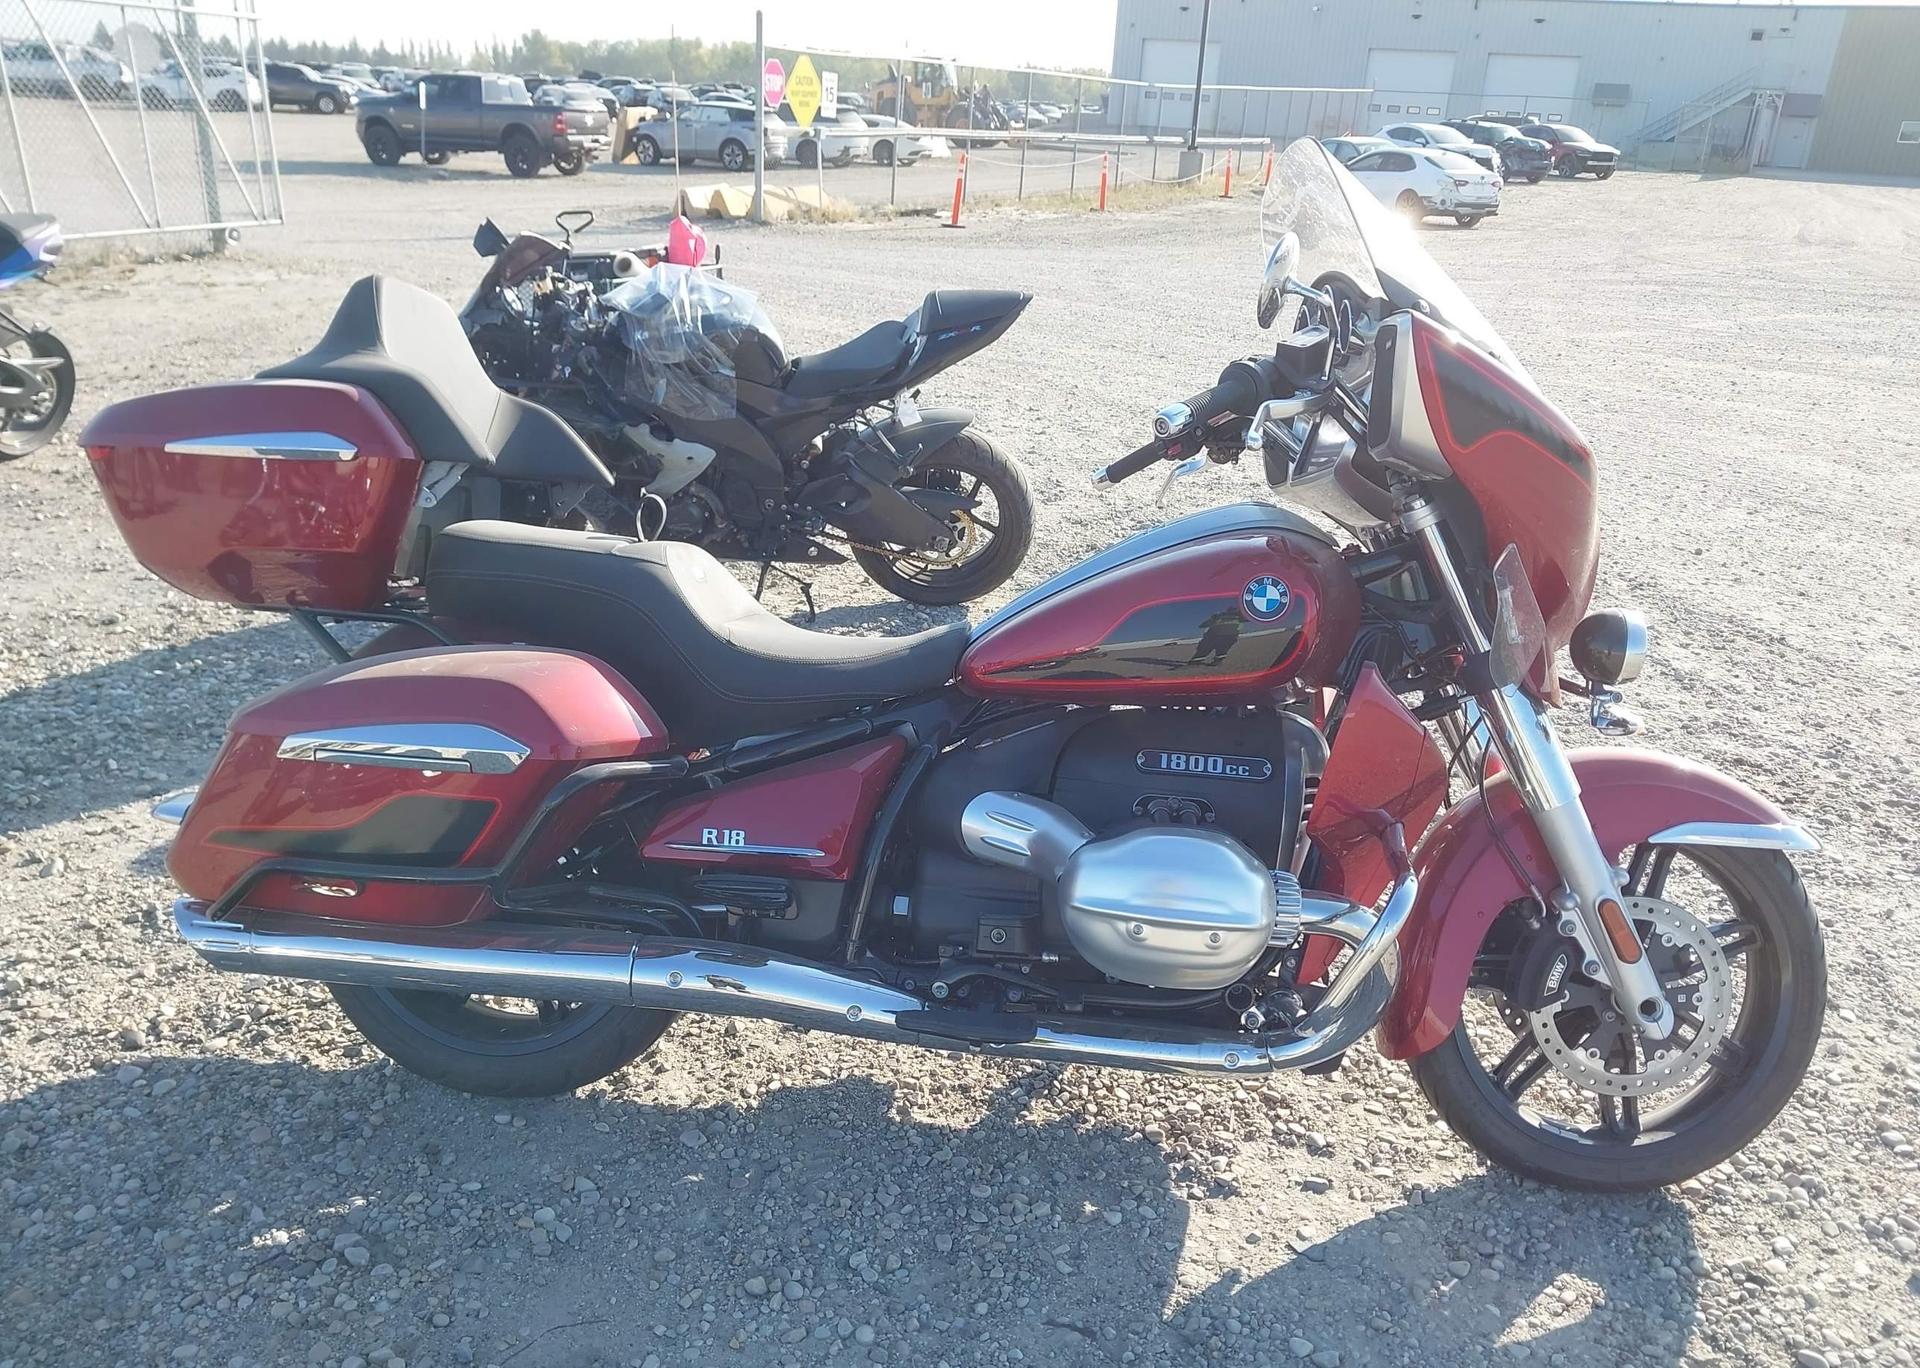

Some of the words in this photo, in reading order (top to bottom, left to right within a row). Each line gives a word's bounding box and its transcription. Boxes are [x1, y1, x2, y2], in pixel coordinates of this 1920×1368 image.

[764, 74, 783, 92] STOP
[825, 86, 834, 103] 15
[1250, 577, 1286, 592] BMW
[1160, 753, 1250, 776] 1800cc
[702, 828, 718, 846] R
[722, 829, 745, 847] 18
[1549, 961, 1565, 988] BMW
